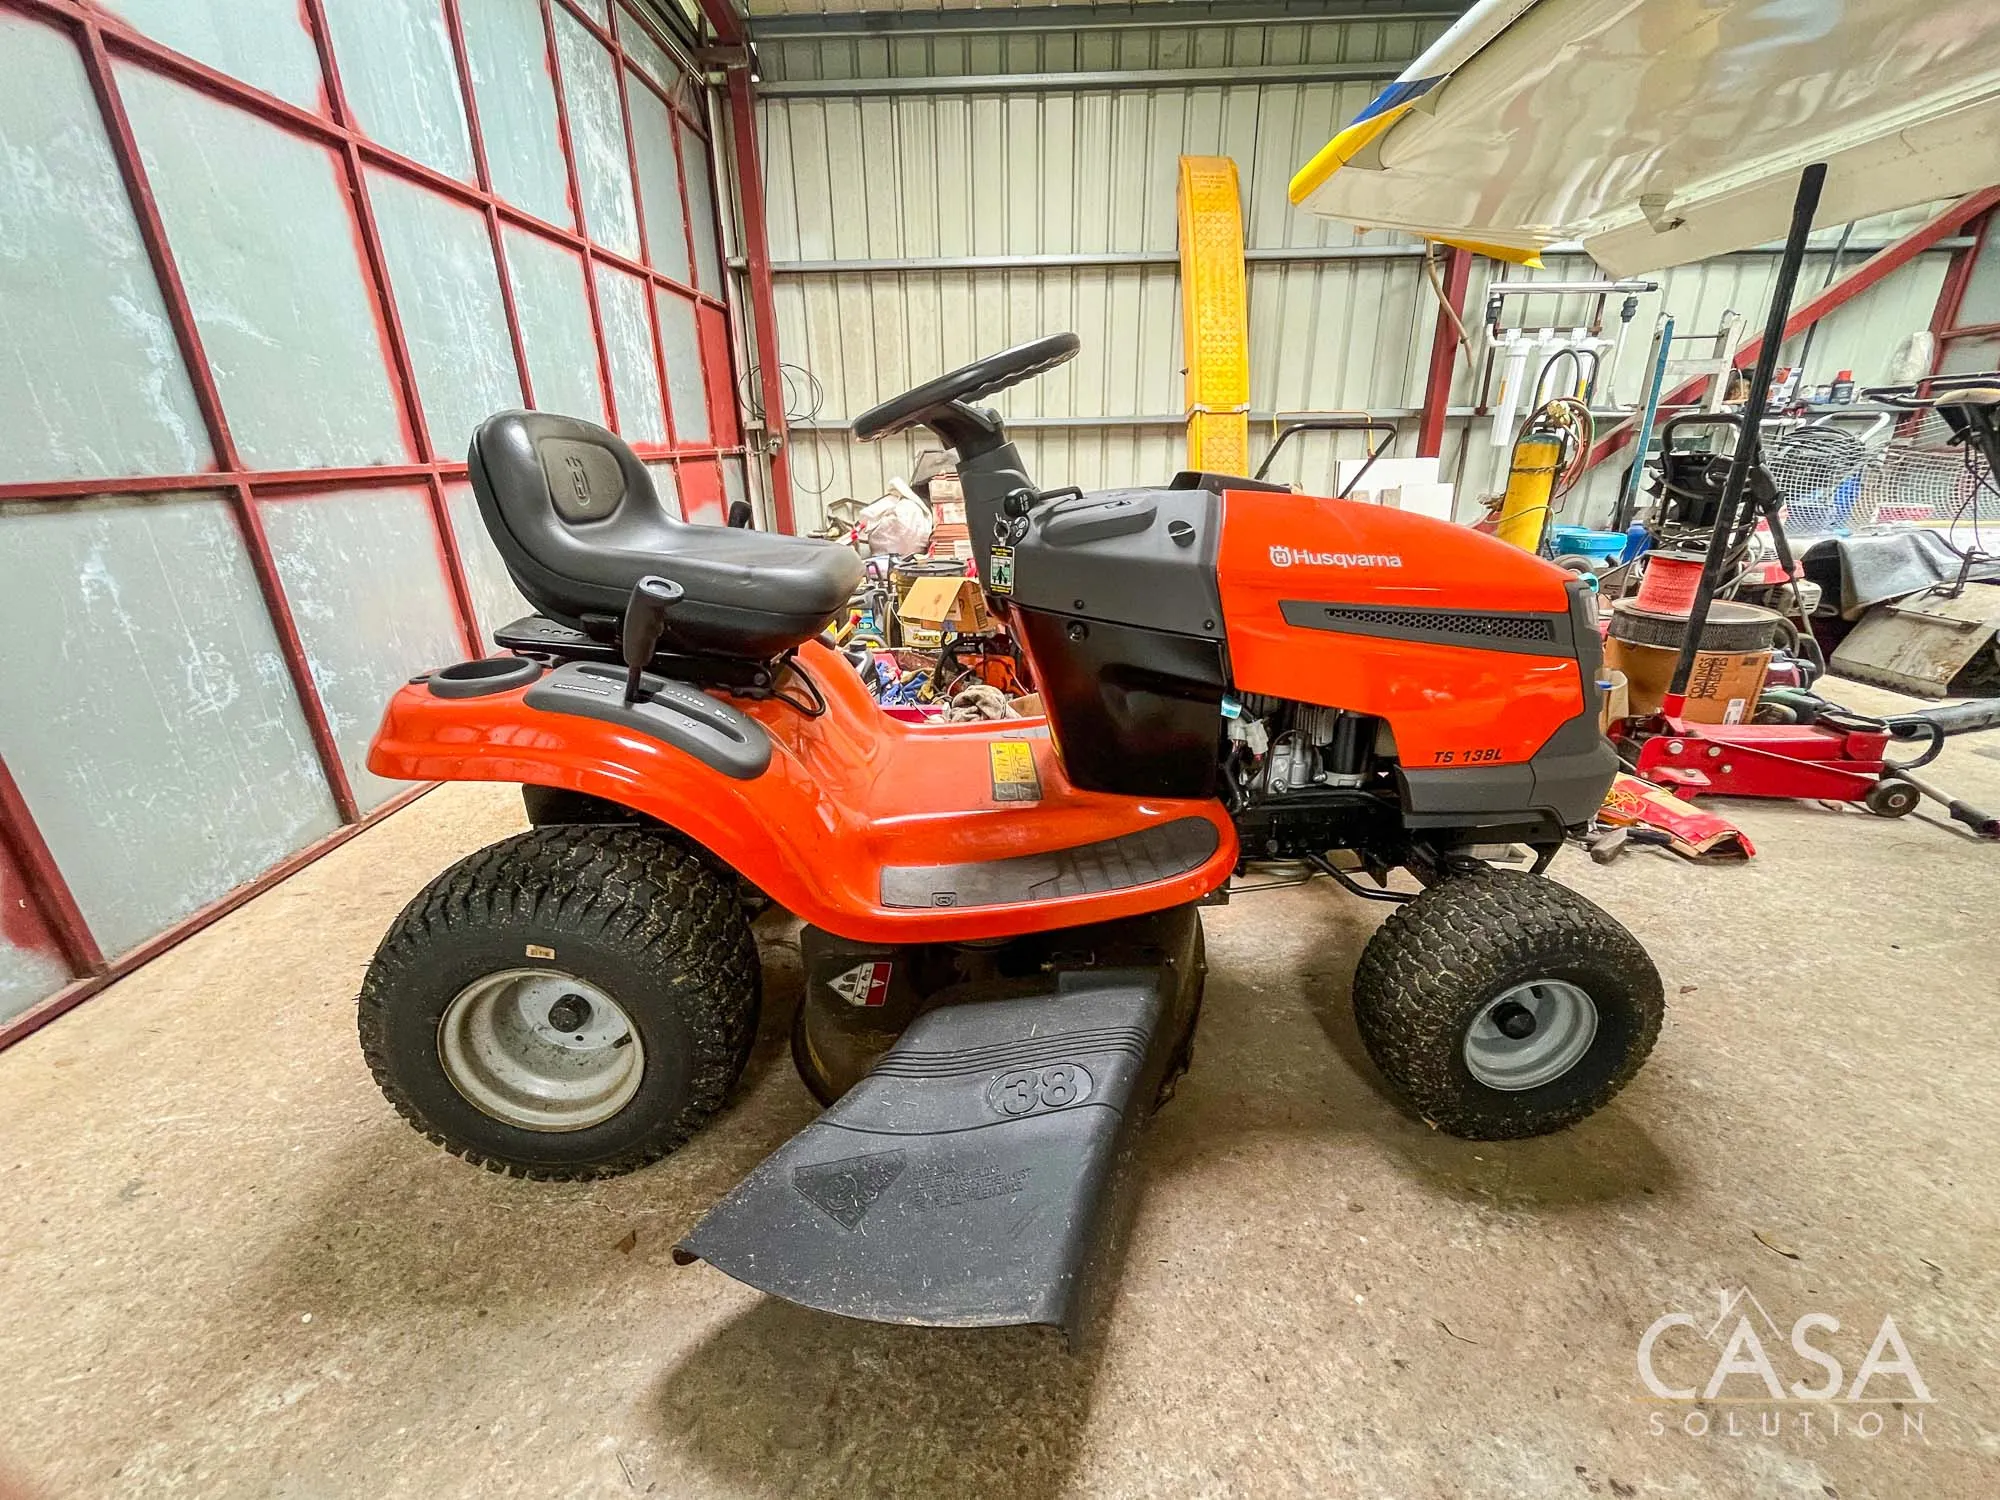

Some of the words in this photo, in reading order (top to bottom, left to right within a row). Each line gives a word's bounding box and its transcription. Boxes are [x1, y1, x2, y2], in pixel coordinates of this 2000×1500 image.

[1293, 549, 1402, 568] Husqvarna
[1688, 657, 1712, 699] COATINGS
[1434, 751, 1455, 763] TS
[1463, 748, 1504, 762] 138L
[1003, 1067, 1077, 1115] 38
